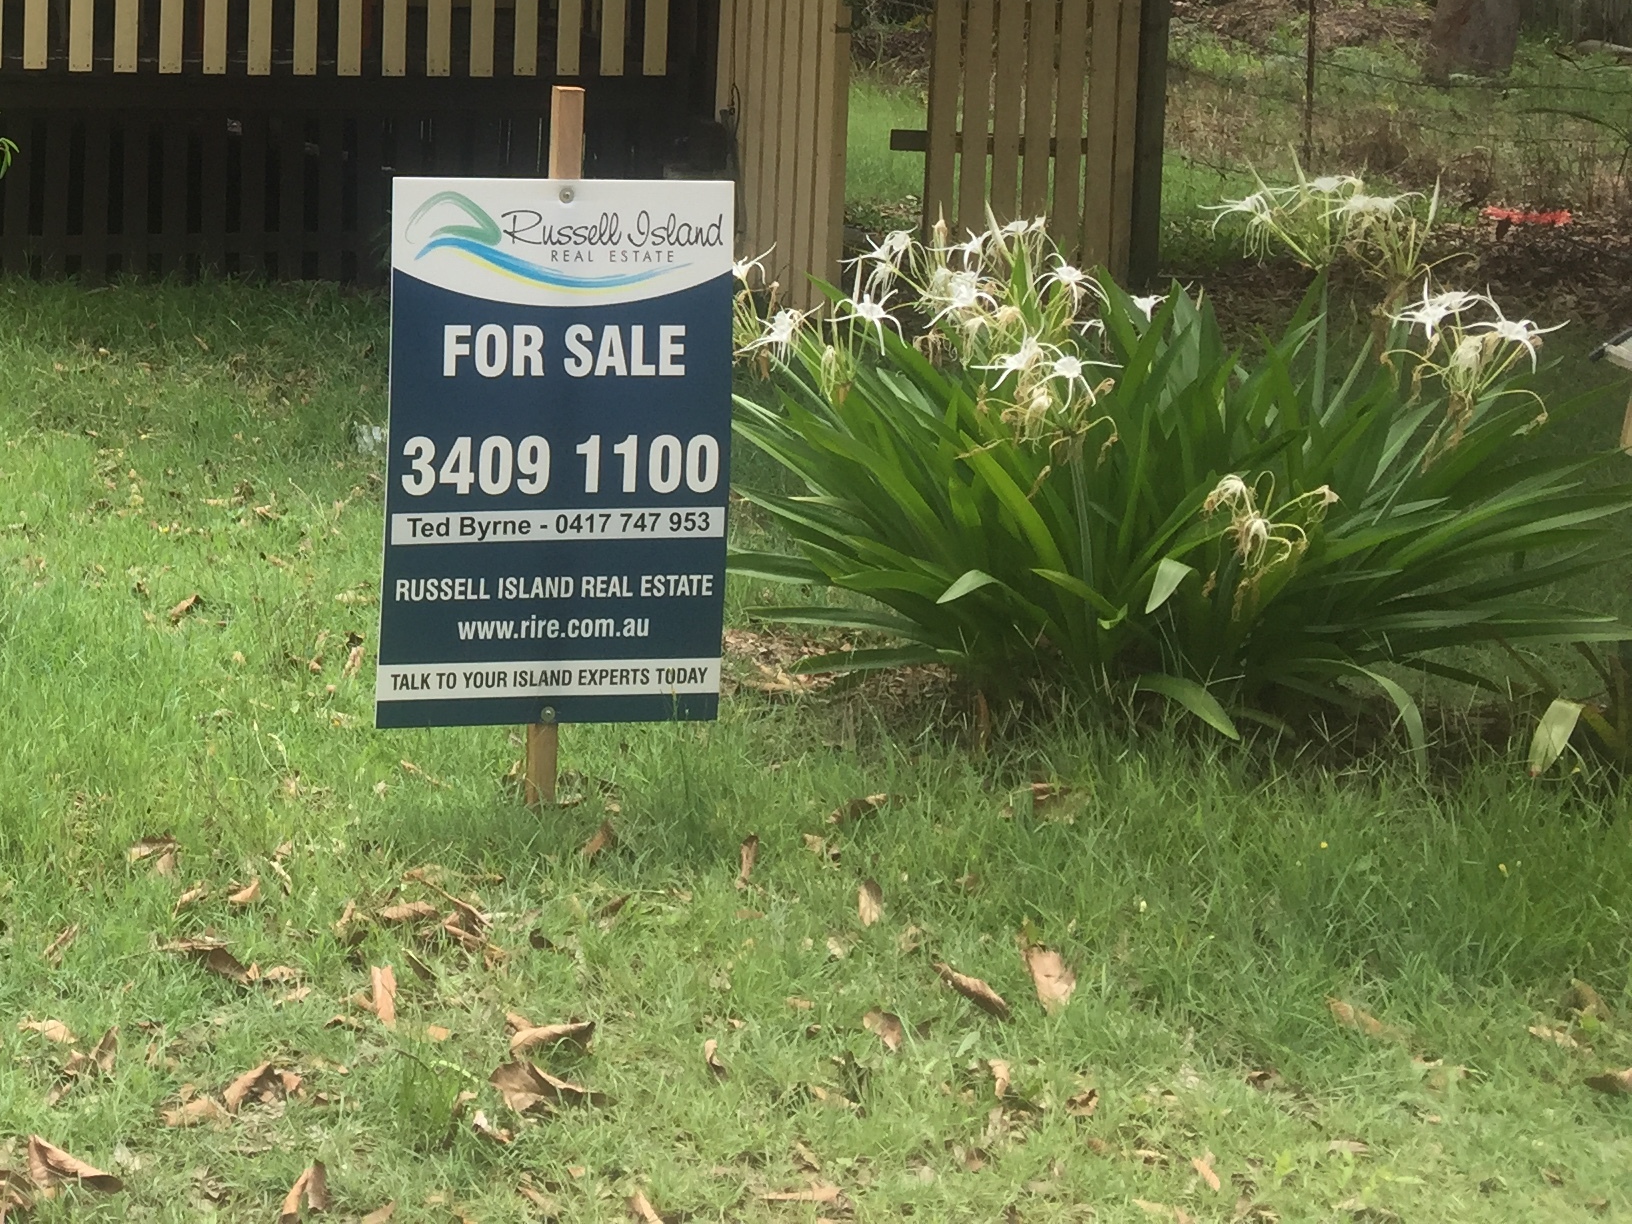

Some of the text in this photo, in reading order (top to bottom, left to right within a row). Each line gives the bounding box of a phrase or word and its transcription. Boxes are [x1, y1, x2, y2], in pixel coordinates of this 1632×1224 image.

[501, 209, 723, 247] Russell Island
[551, 250, 674, 263] REAL ESTATE
[443, 324, 686, 377] FOR SALE
[401, 434, 719, 496] 3409 1100
[407, 517, 450, 538] Ted
[460, 516, 531, 541] Byrne
[555, 513, 611, 534] 0417
[620, 513, 661, 532] 747
[669, 512, 710, 532] 953
[396, 575, 713, 601] RUSSELL ISLAND REAL ESTATE
[458, 615, 649, 640] www.rire.com.au
[391, 667, 708, 691] TALK TO YOUR ISLAND EXPERTS TODAY
